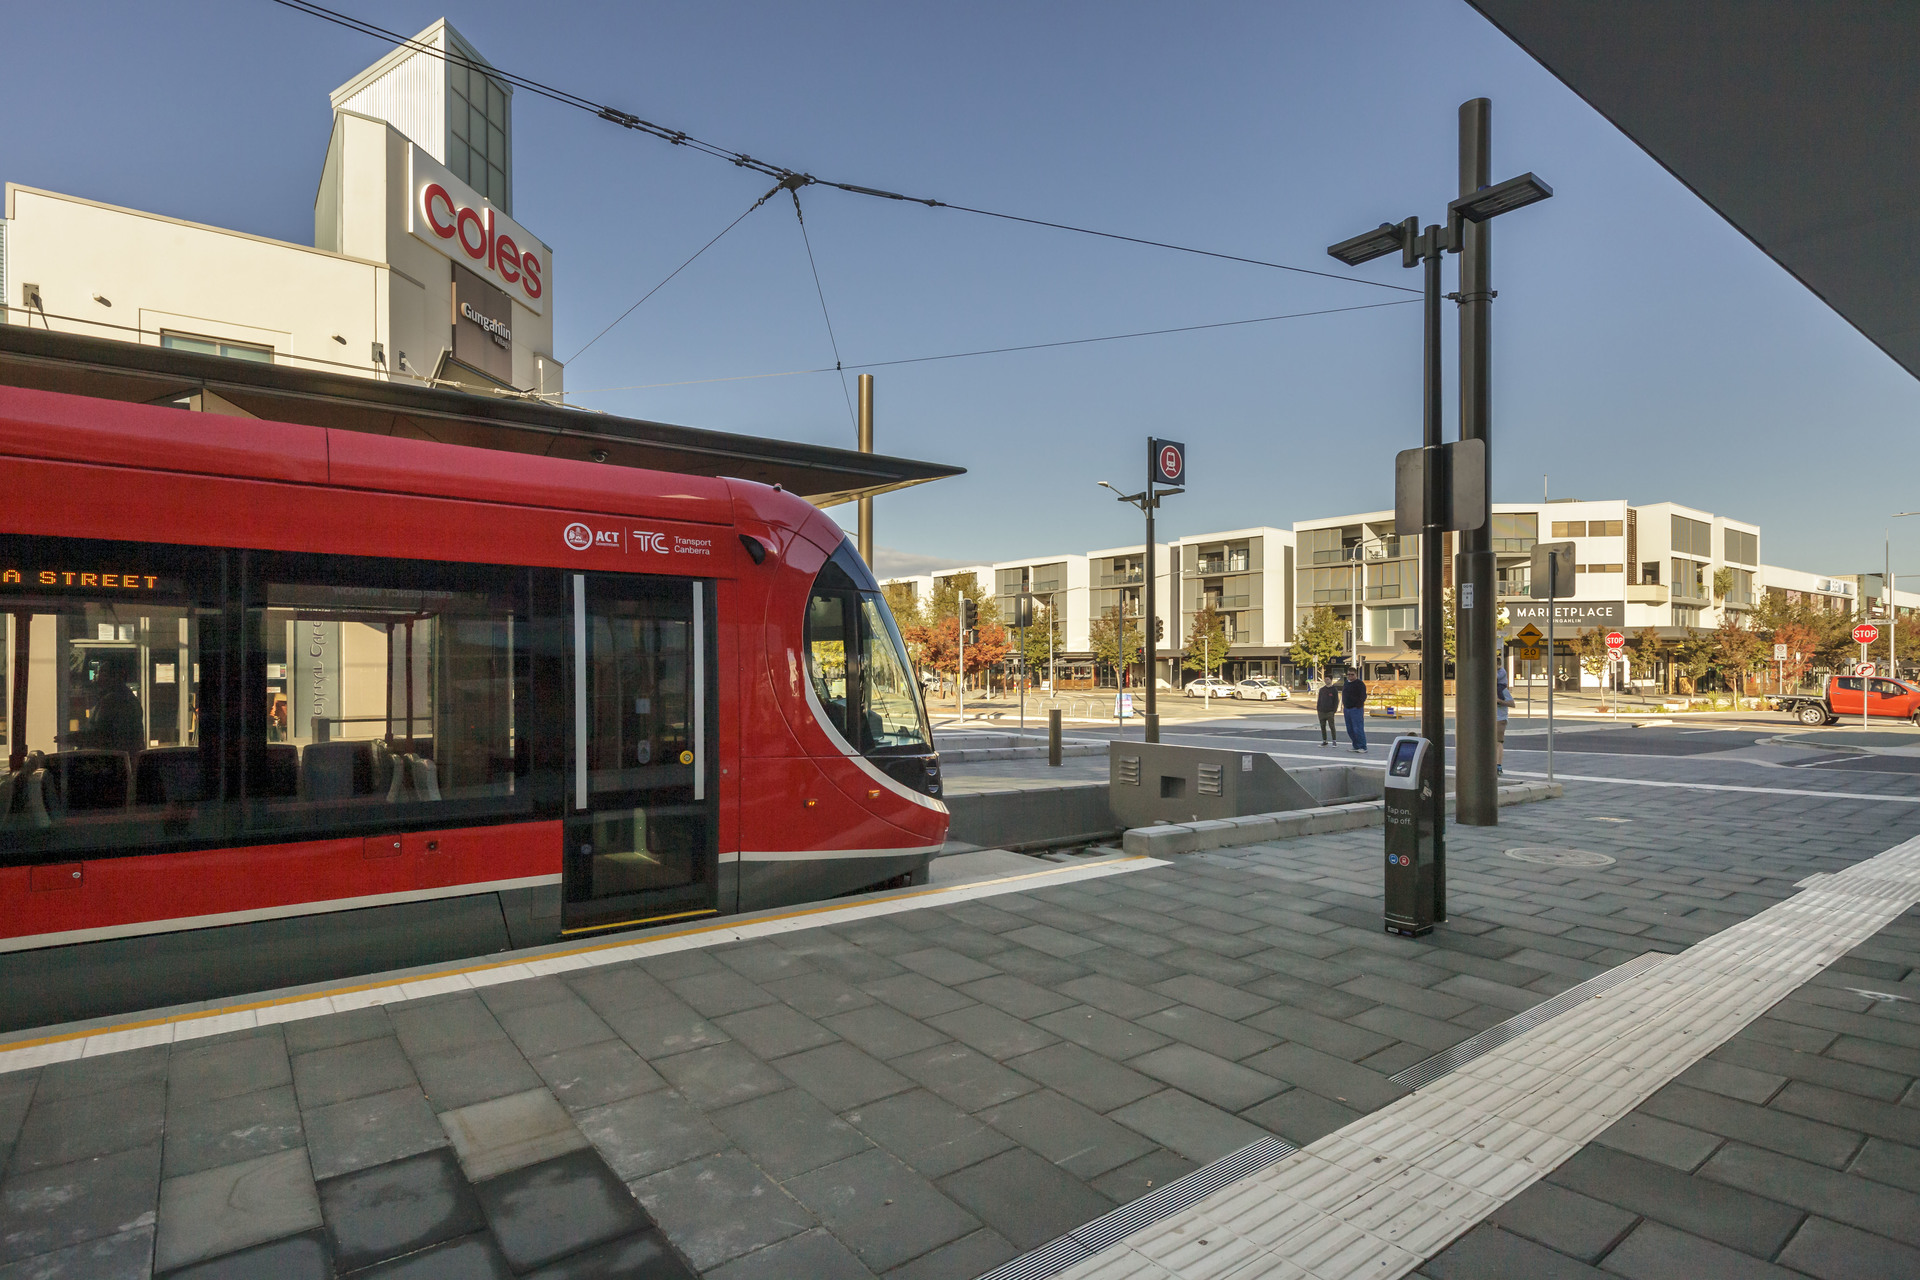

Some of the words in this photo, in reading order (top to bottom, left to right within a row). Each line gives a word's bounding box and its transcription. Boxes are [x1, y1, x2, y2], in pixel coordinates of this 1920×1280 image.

[421, 183, 542, 299] coles
[461, 302, 511, 341] Gungahlin
[595, 530, 620, 543] ACT
[632, 530, 669, 554] TC
[674, 535, 712, 547] Transport
[674, 545, 710, 556] Canberra
[39, 570, 158, 589] STREET
[1854, 629, 1877, 638] STOP
[1605, 635, 1625, 646] STOP
[1523, 648, 1537, 656] 20
[1387, 805, 1399, 815] Tap
[1386, 815, 1399, 825] Tap
